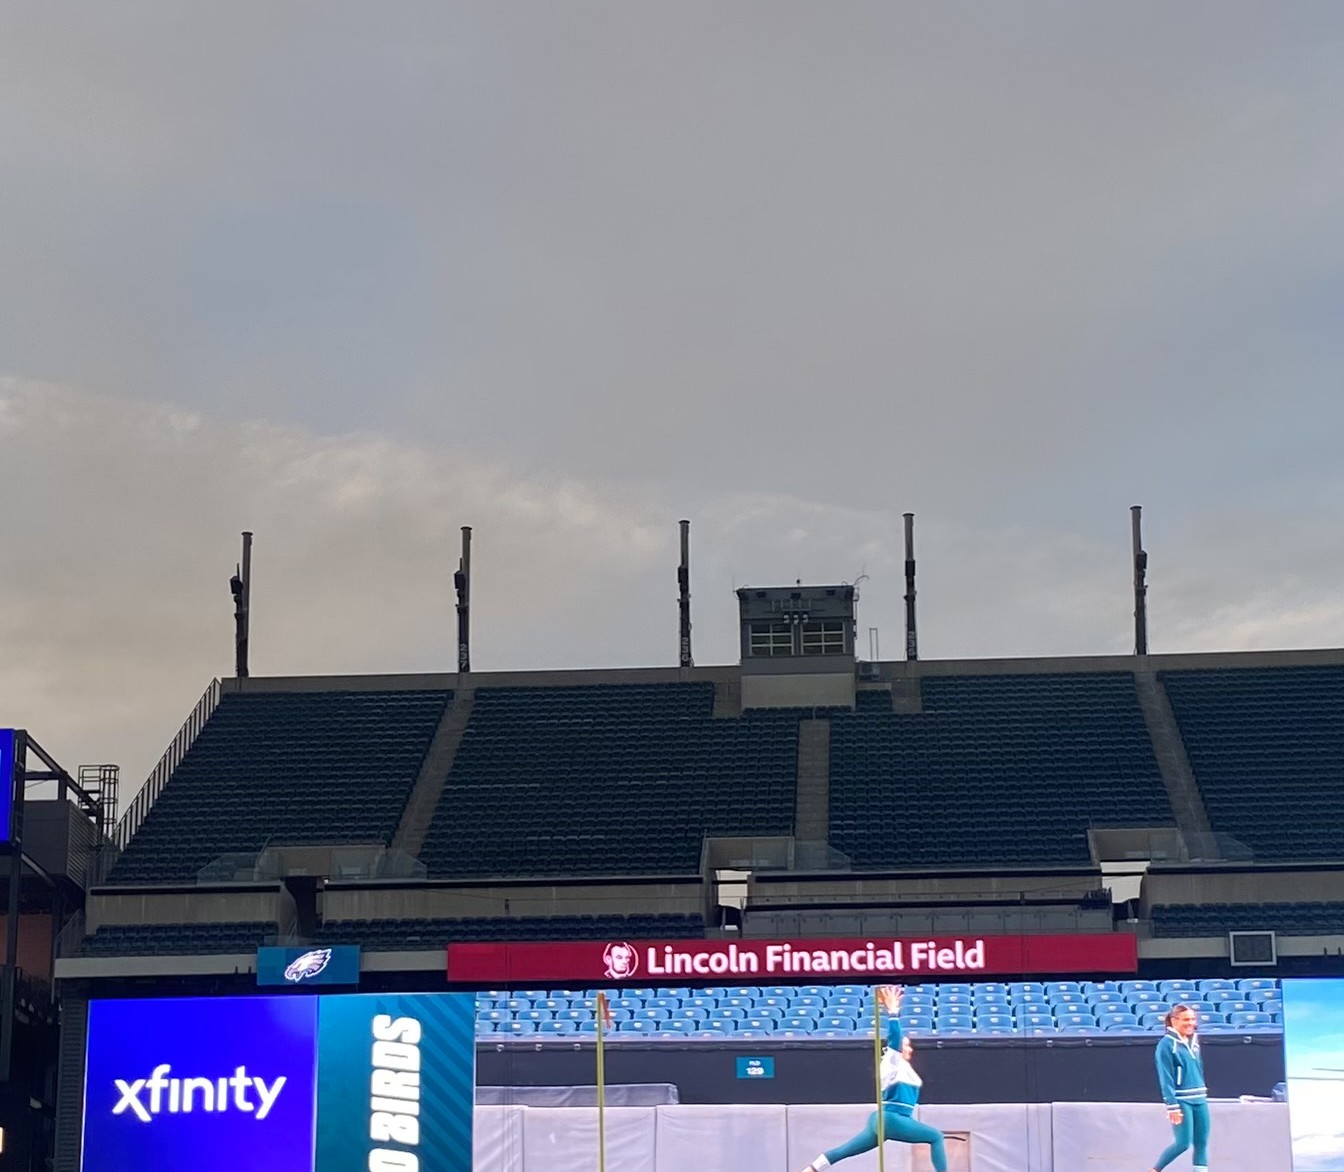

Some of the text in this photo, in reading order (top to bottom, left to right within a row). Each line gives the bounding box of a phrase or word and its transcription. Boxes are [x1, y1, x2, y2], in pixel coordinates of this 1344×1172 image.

[647, 940, 985, 975] Lincoln Financial Field
[112, 1064, 287, 1122] xfinity
[369, 1014, 422, 1146] BIRDS
